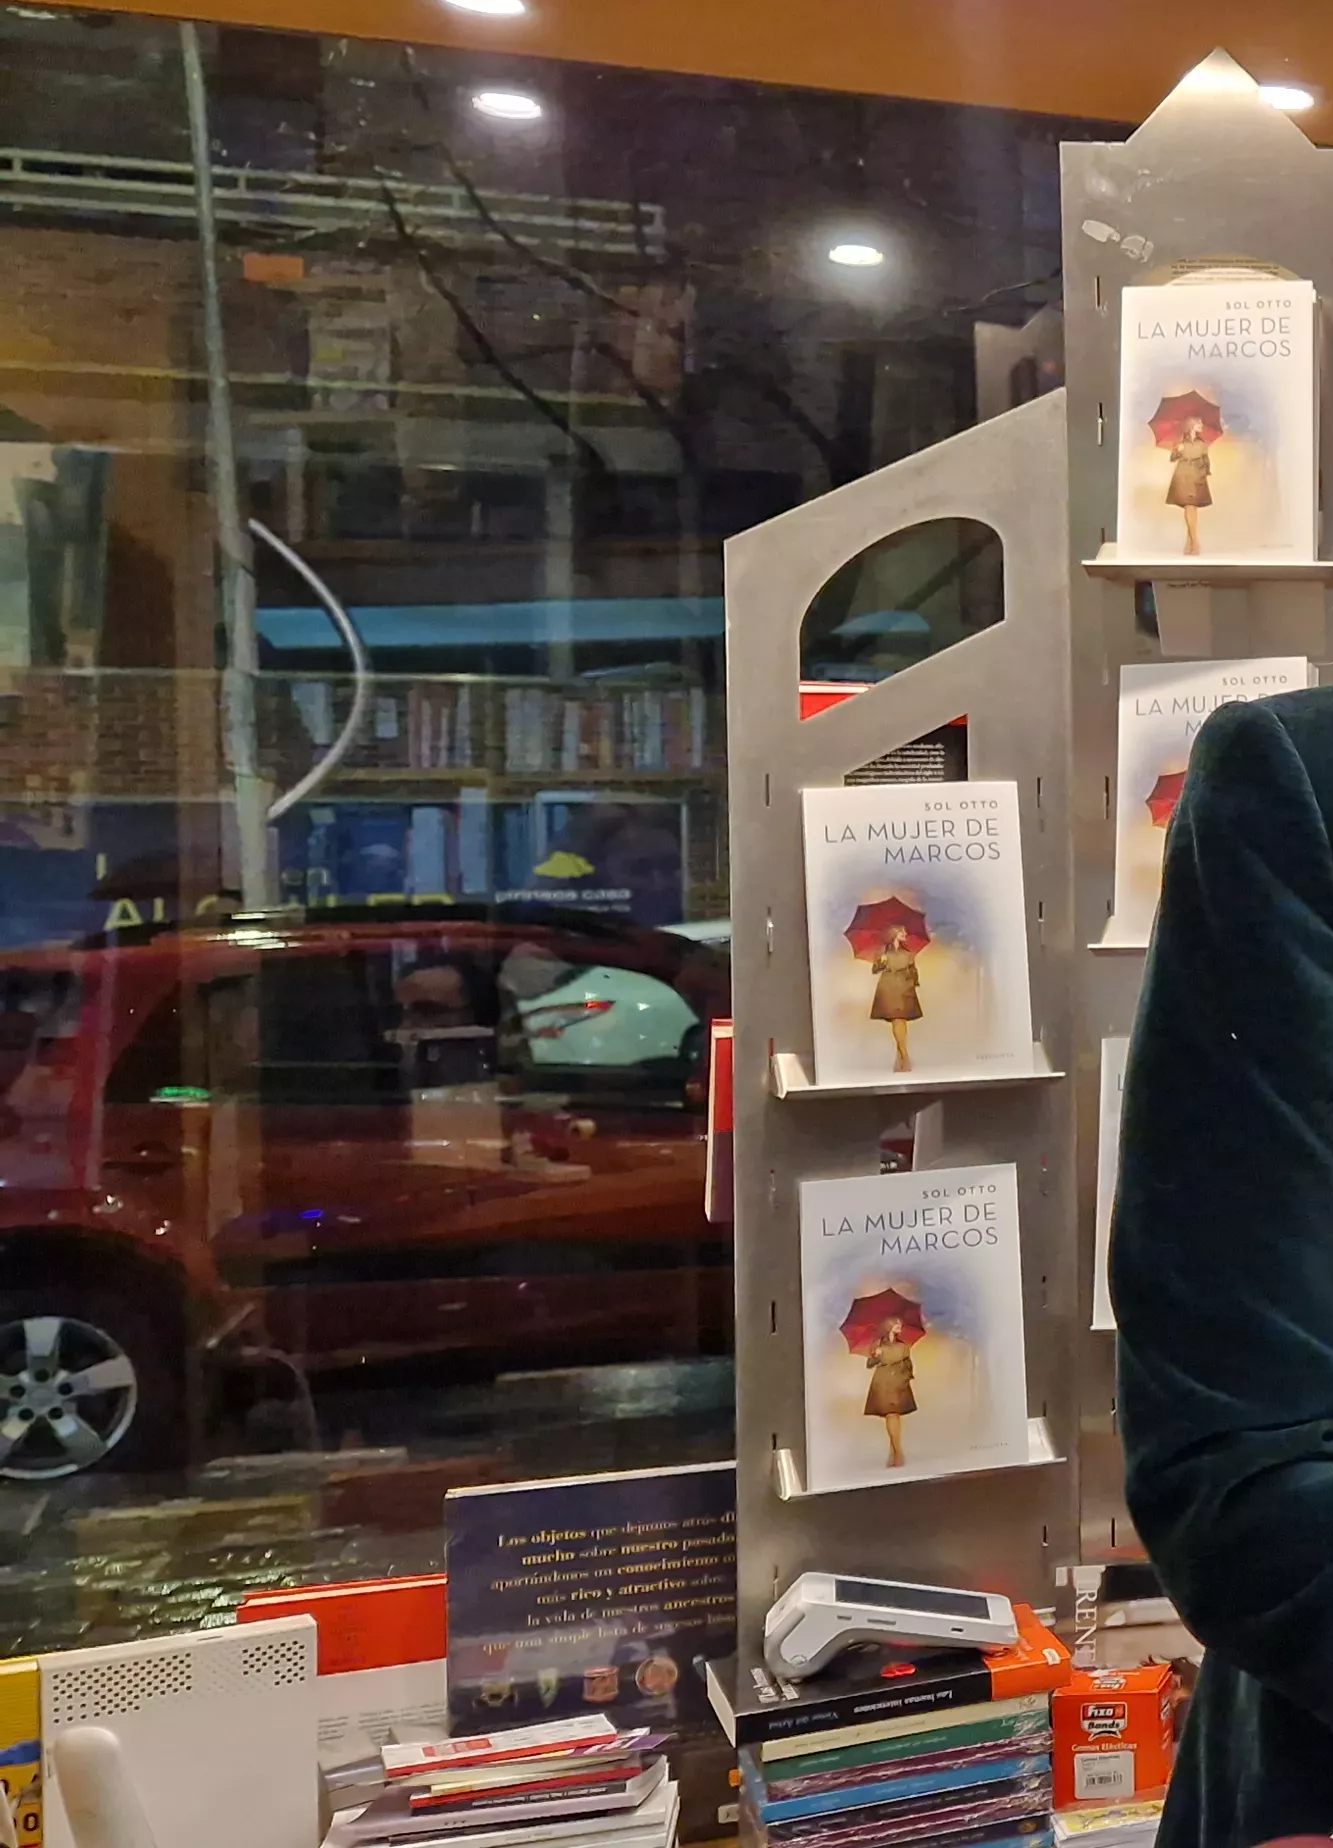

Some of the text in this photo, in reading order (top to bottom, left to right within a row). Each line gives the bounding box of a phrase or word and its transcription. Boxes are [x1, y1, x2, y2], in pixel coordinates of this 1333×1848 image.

[1225, 299, 1292, 310] SOL OTTO
[1138, 316, 1291, 339] LA MUJER DE
[1188, 340, 1292, 359] MARCOS
[1222, 675, 1288, 686] SOL OTTO
[1135, 698, 1163, 716] LA
[924, 800, 999, 812] SOL OTTO
[824, 817, 999, 843] LA MUJER DE
[884, 842, 1001, 864] MARCOS
[922, 1184, 997, 1199] SOL OTTO
[822, 1203, 997, 1237] LA MUJER DE
[881, 1227, 999, 1256] MARCOS
[498, 1534, 526, 1547] Los
[531, 1529, 586, 1545] objetos
[591, 1526, 616, 1540] que
[521, 1550, 575, 1566] mucho
[620, 1539, 678, 1555] nuestro
[617, 1554, 718, 1576] conocimiento
[571, 1588, 602, 1600] rico
[606, 1588, 613, 1601] y
[618, 1578, 686, 1596] atractivo
[527, 1614, 540, 1627] la
[581, 1608, 596, 1620] de
[602, 1602, 659, 1619] nuestros
[663, 1595, 735, 1611] ancestros
[853, 1698, 903, 1715] intenciones
[904, 1694, 936, 1706] buenas
[1087, 1720, 1120, 1730] Bands
